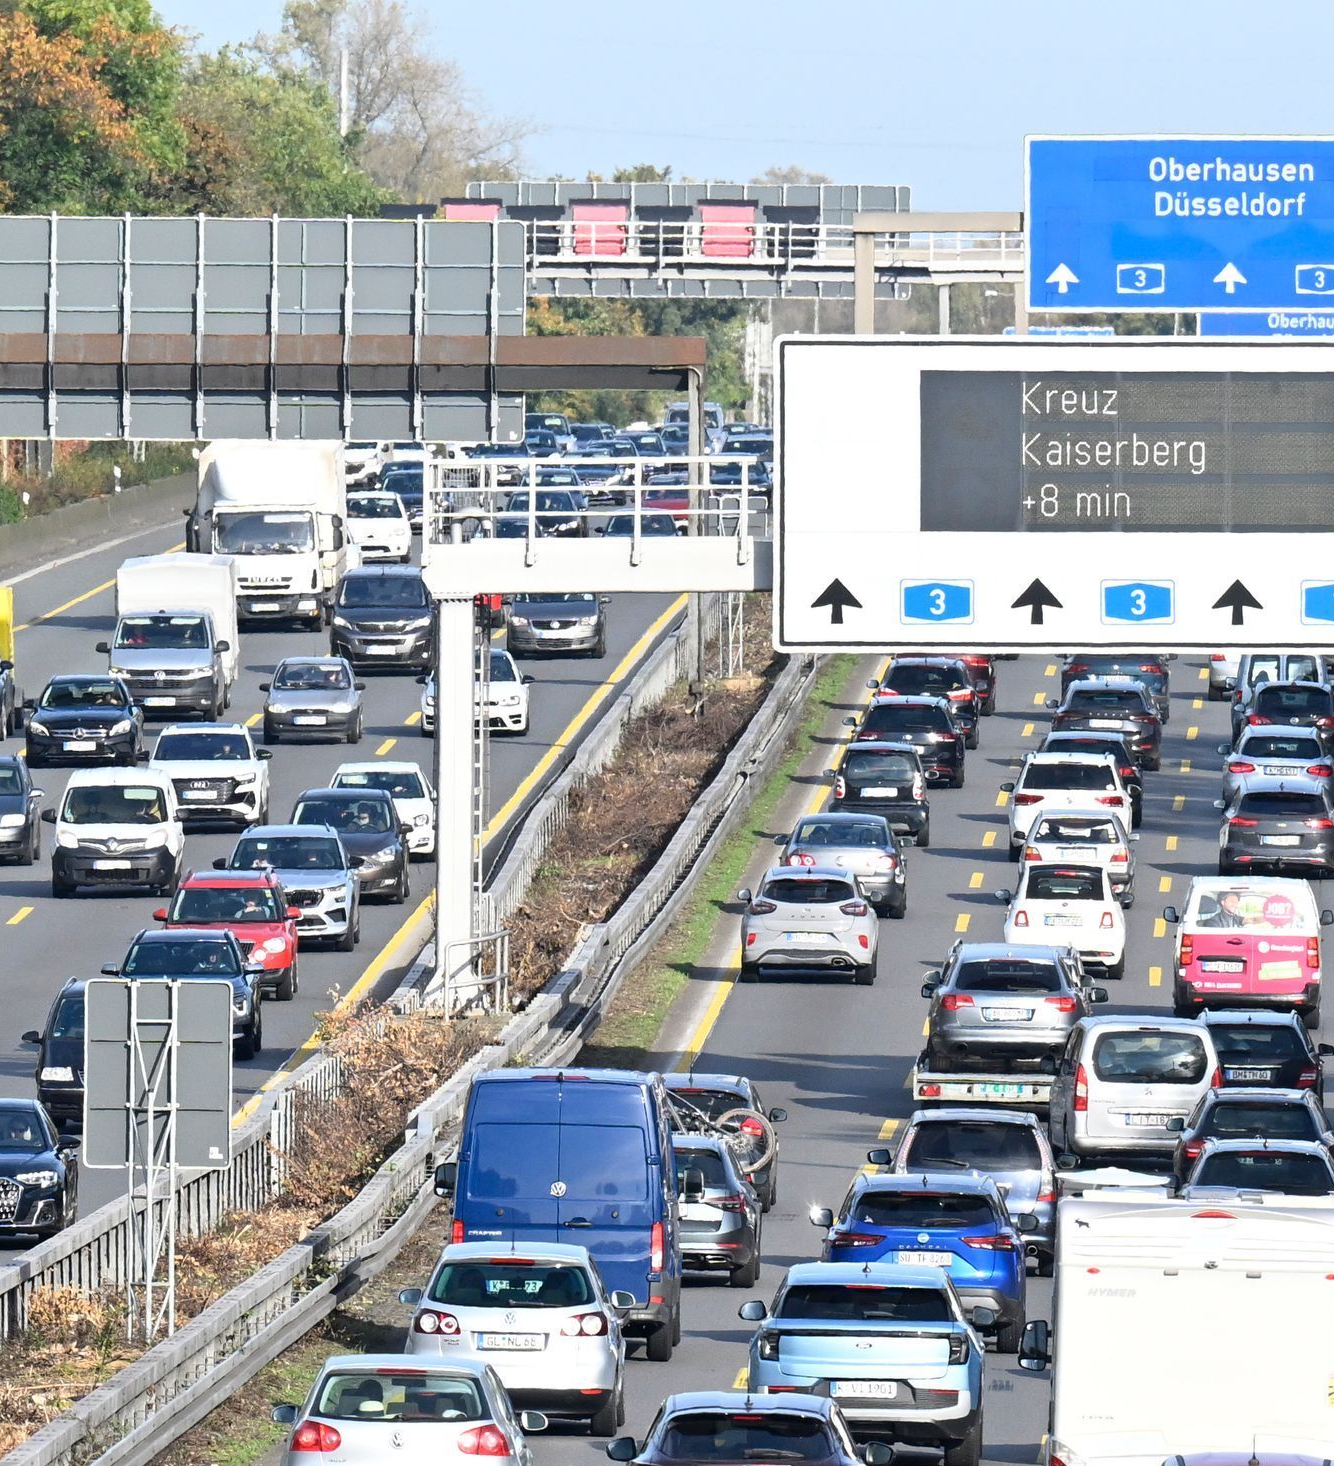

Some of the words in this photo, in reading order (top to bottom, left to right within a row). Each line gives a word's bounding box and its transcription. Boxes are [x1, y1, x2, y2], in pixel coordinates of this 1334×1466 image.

[1148, 156, 1315, 182] Oberhausen
[1154, 191, 1307, 217] Düsseldorf
[1134, 269, 1147, 288] 3
[1314, 270, 1326, 289] 3
[1022, 381, 1118, 416] Kreuz
[1022, 433, 1207, 475] Kaiserberg
[1022, 484, 1059, 518] +8
[1076, 484, 1131, 517] min
[929, 589, 946, 615] 3
[1130, 589, 1147, 616] 3
